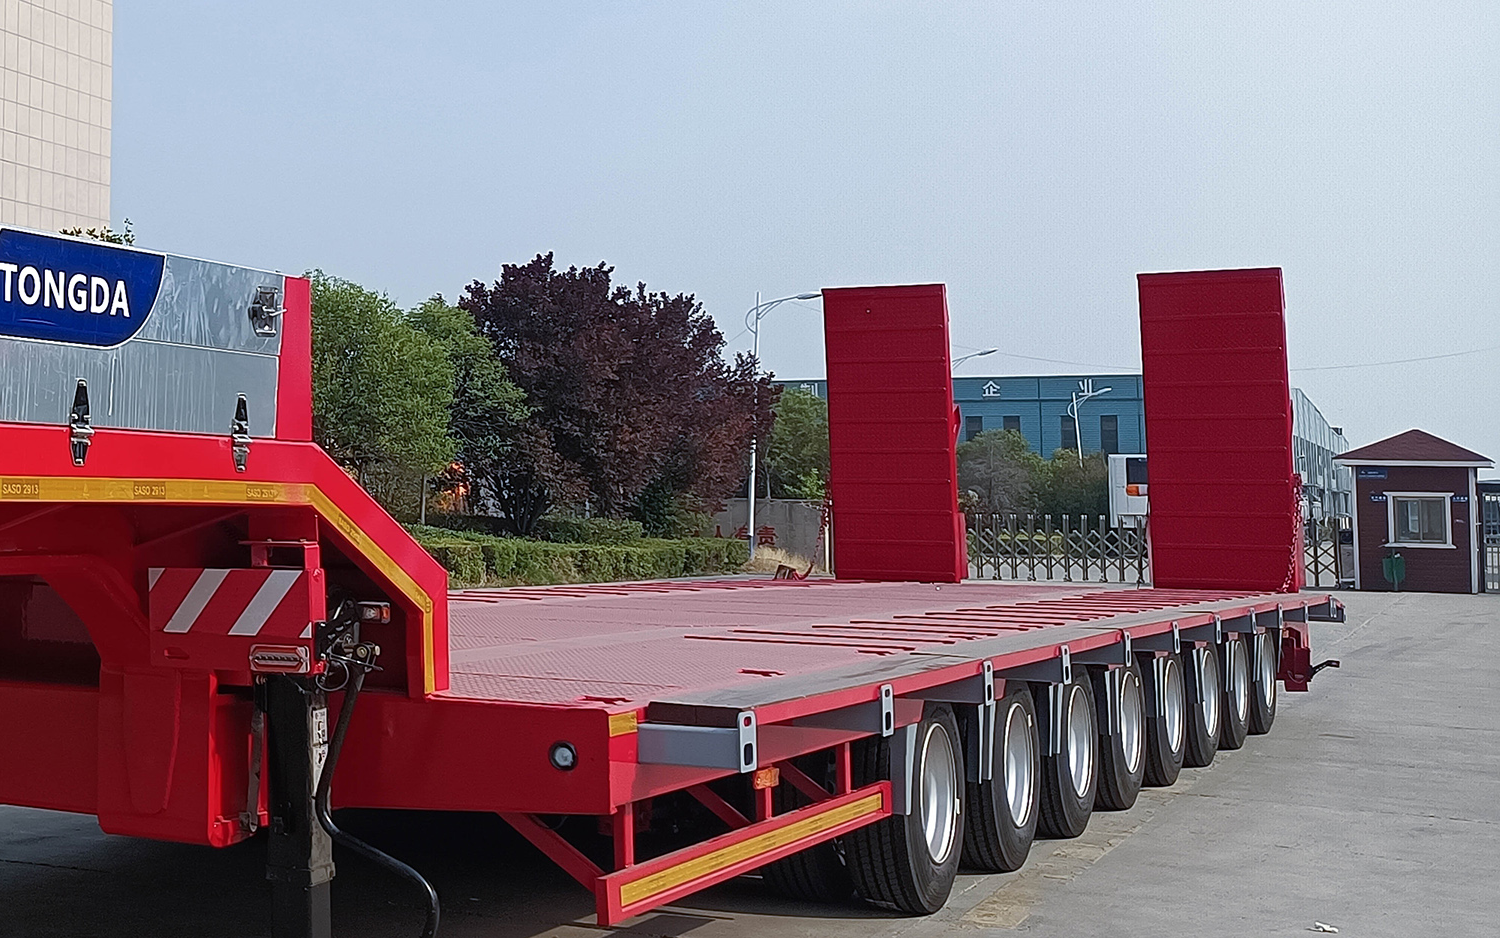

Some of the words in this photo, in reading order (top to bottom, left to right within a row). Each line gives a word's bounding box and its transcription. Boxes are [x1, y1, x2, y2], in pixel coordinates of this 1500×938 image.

[2, 483, 22, 495] SASO
[23, 484, 39, 495] 2913
[133, 485, 151, 496] SASO
